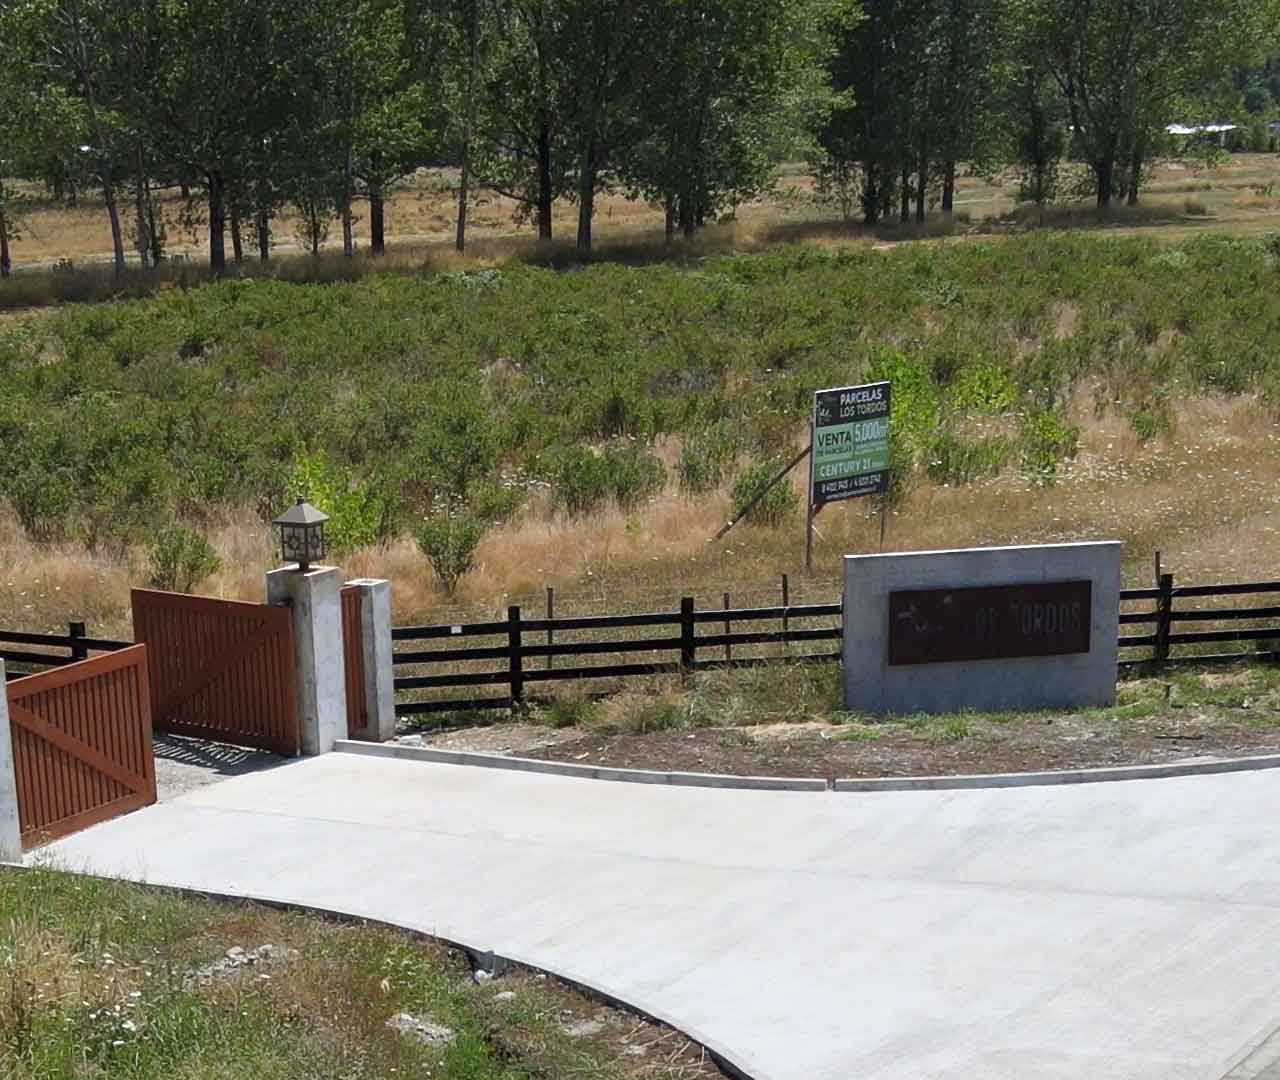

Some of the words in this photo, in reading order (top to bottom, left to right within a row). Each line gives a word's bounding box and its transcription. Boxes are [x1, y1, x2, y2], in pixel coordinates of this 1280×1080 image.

[840, 388, 882, 405] PARCELAS
[840, 405, 855, 418] LOS
[817, 431, 851, 446] VENTA
[820, 460, 861, 477] CENTURY
